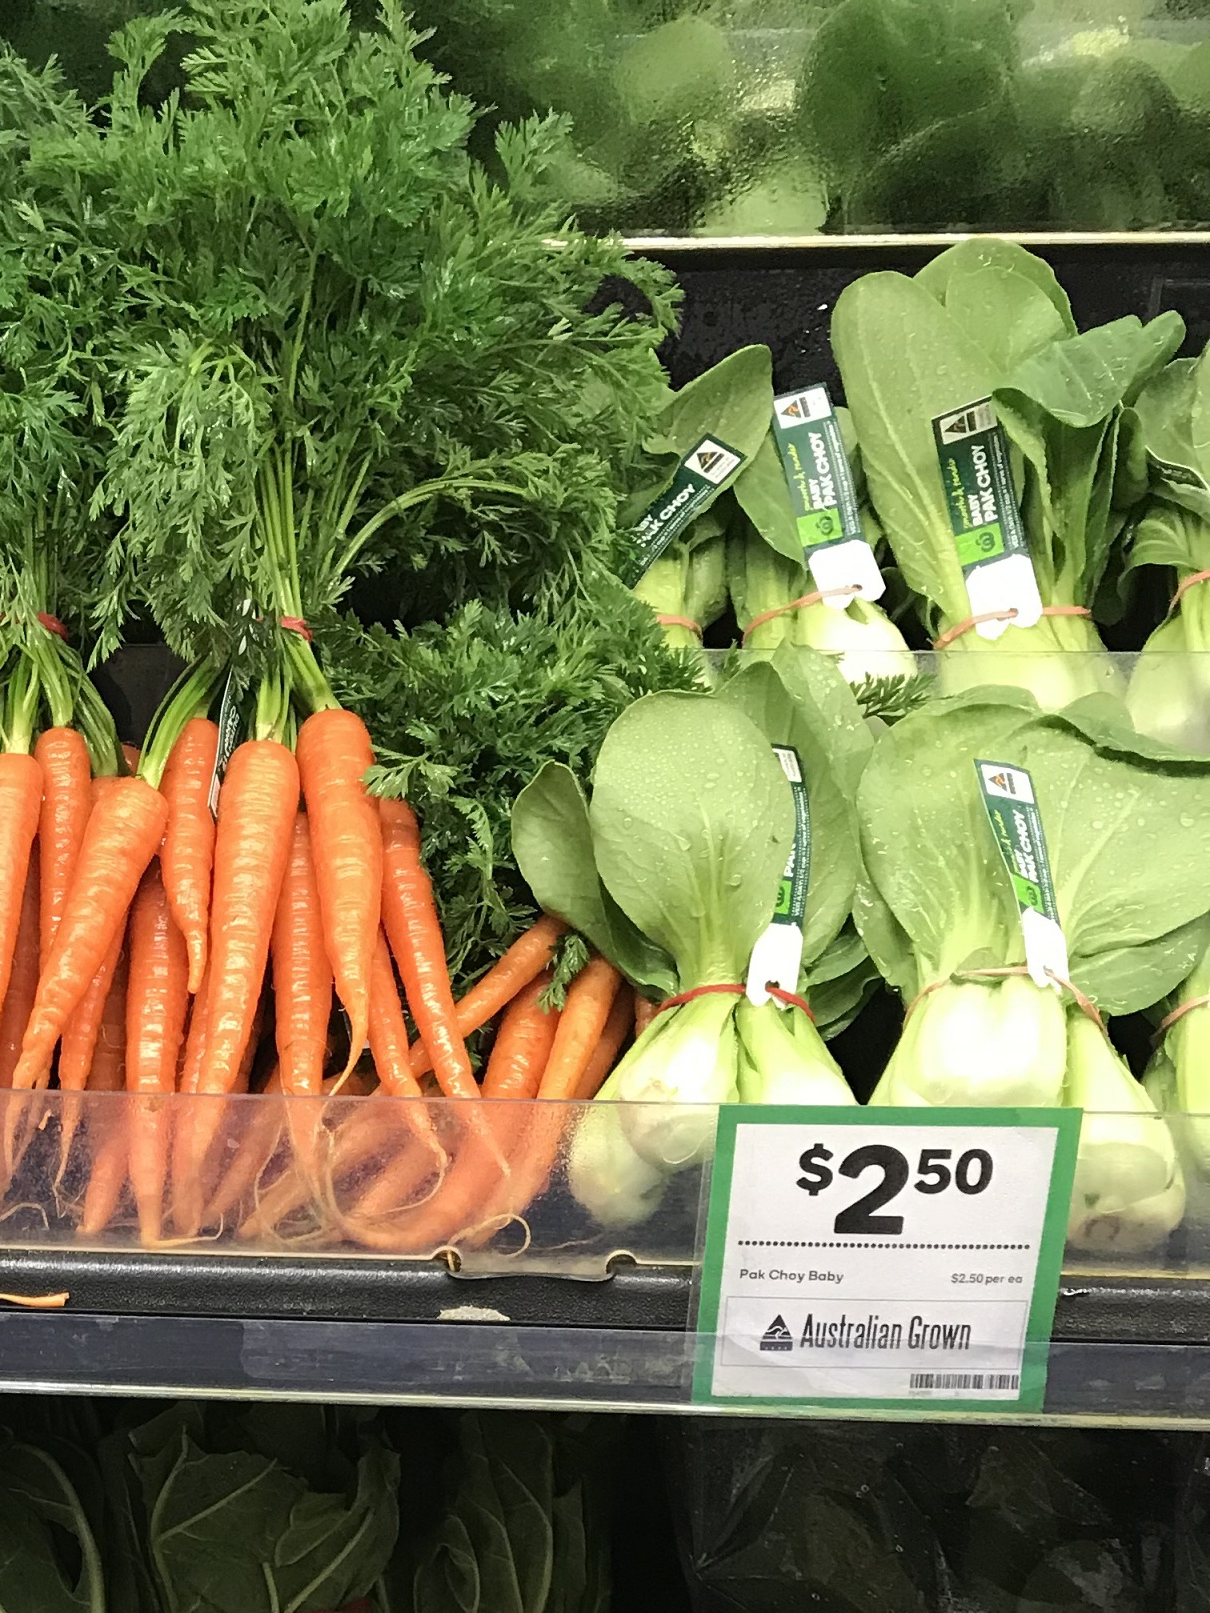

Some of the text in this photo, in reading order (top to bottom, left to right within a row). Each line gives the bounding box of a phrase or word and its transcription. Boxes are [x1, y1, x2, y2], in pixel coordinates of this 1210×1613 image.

[808, 432, 837, 507] PAK CHOY
[971, 445, 991, 488] CHOY
[660, 483, 695, 520] CHOY
[808, 478, 822, 510] BABY
[967, 494, 983, 527] BABY
[980, 487, 998, 522] PAK
[1012, 809, 1032, 853] CHOY
[739, 1268, 844, 1284] Pak Choy Baby
[951, 1273, 1023, 1286] $2.50 per ea
[799, 1313, 971, 1350] Australian Grown
